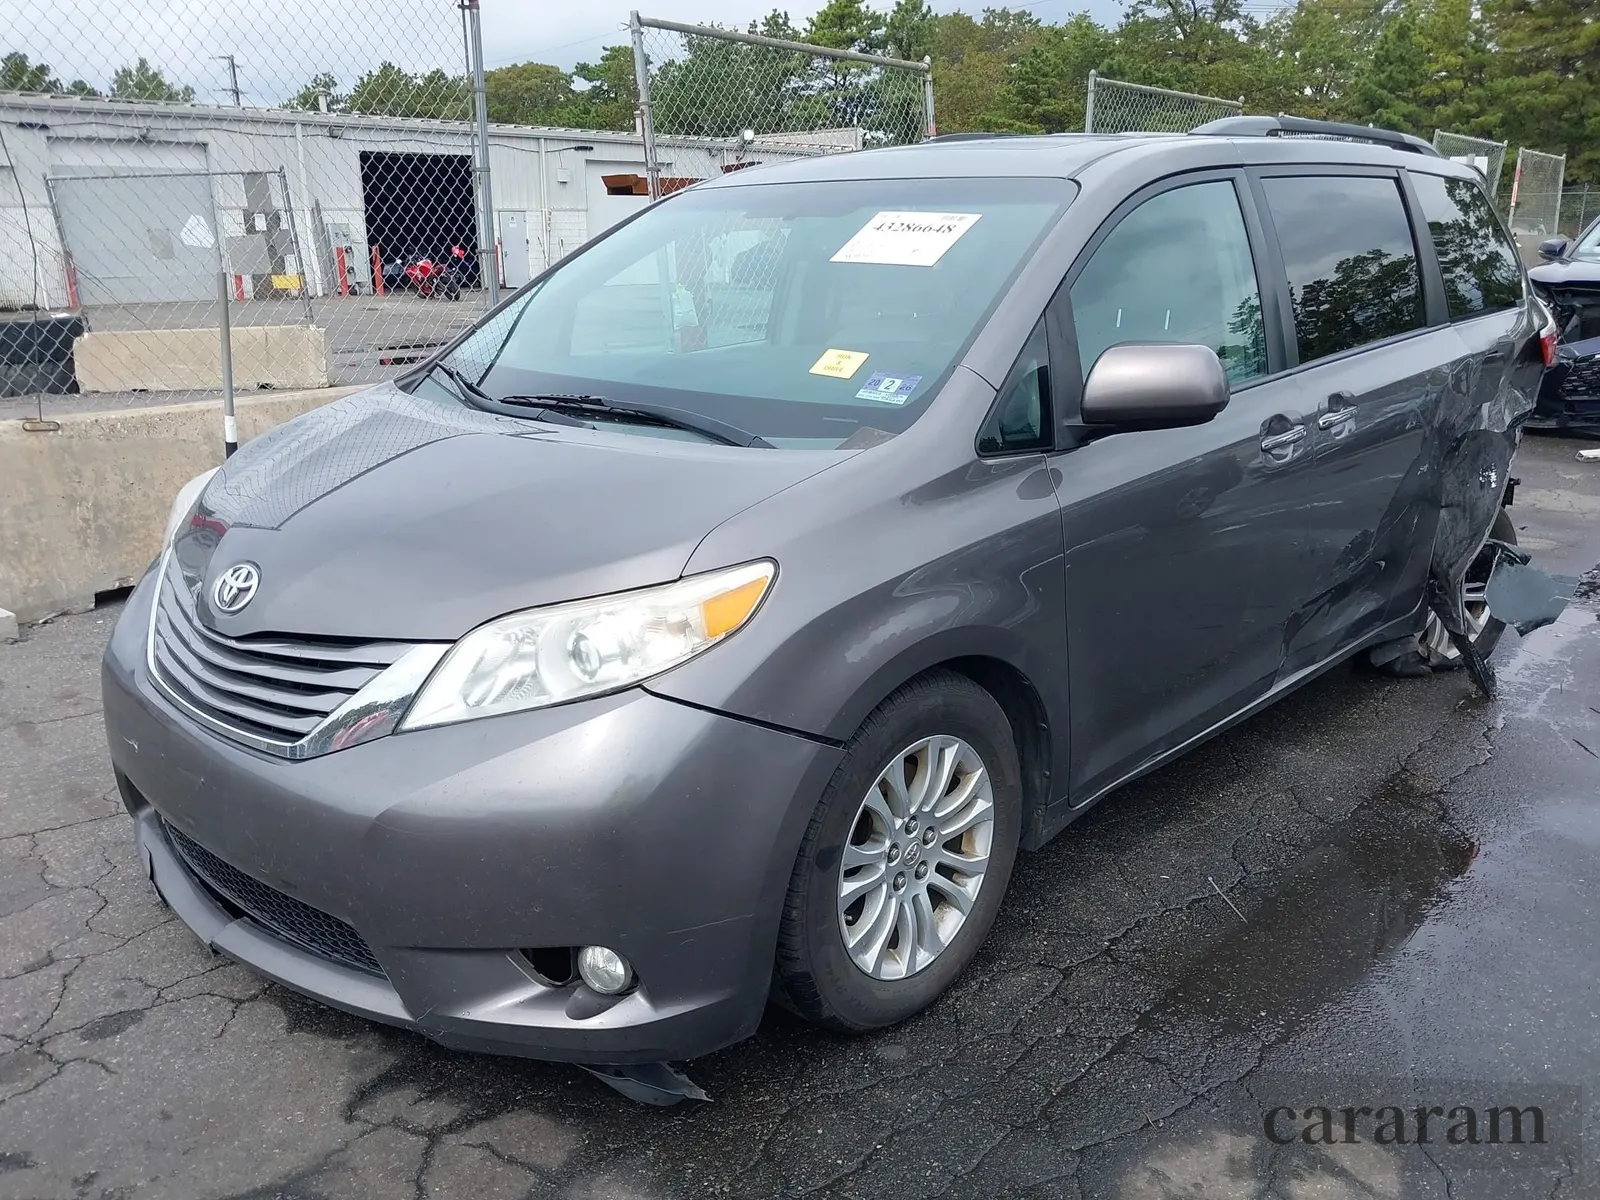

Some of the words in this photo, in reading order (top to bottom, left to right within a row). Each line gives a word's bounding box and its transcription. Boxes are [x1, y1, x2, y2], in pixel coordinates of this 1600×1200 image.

[873, 221, 956, 234] 43286648
[823, 364, 844, 373] DRIVE
[868, 378, 881, 387] 20
[884, 380, 896, 391] 2
[899, 383, 912, 392] 26
